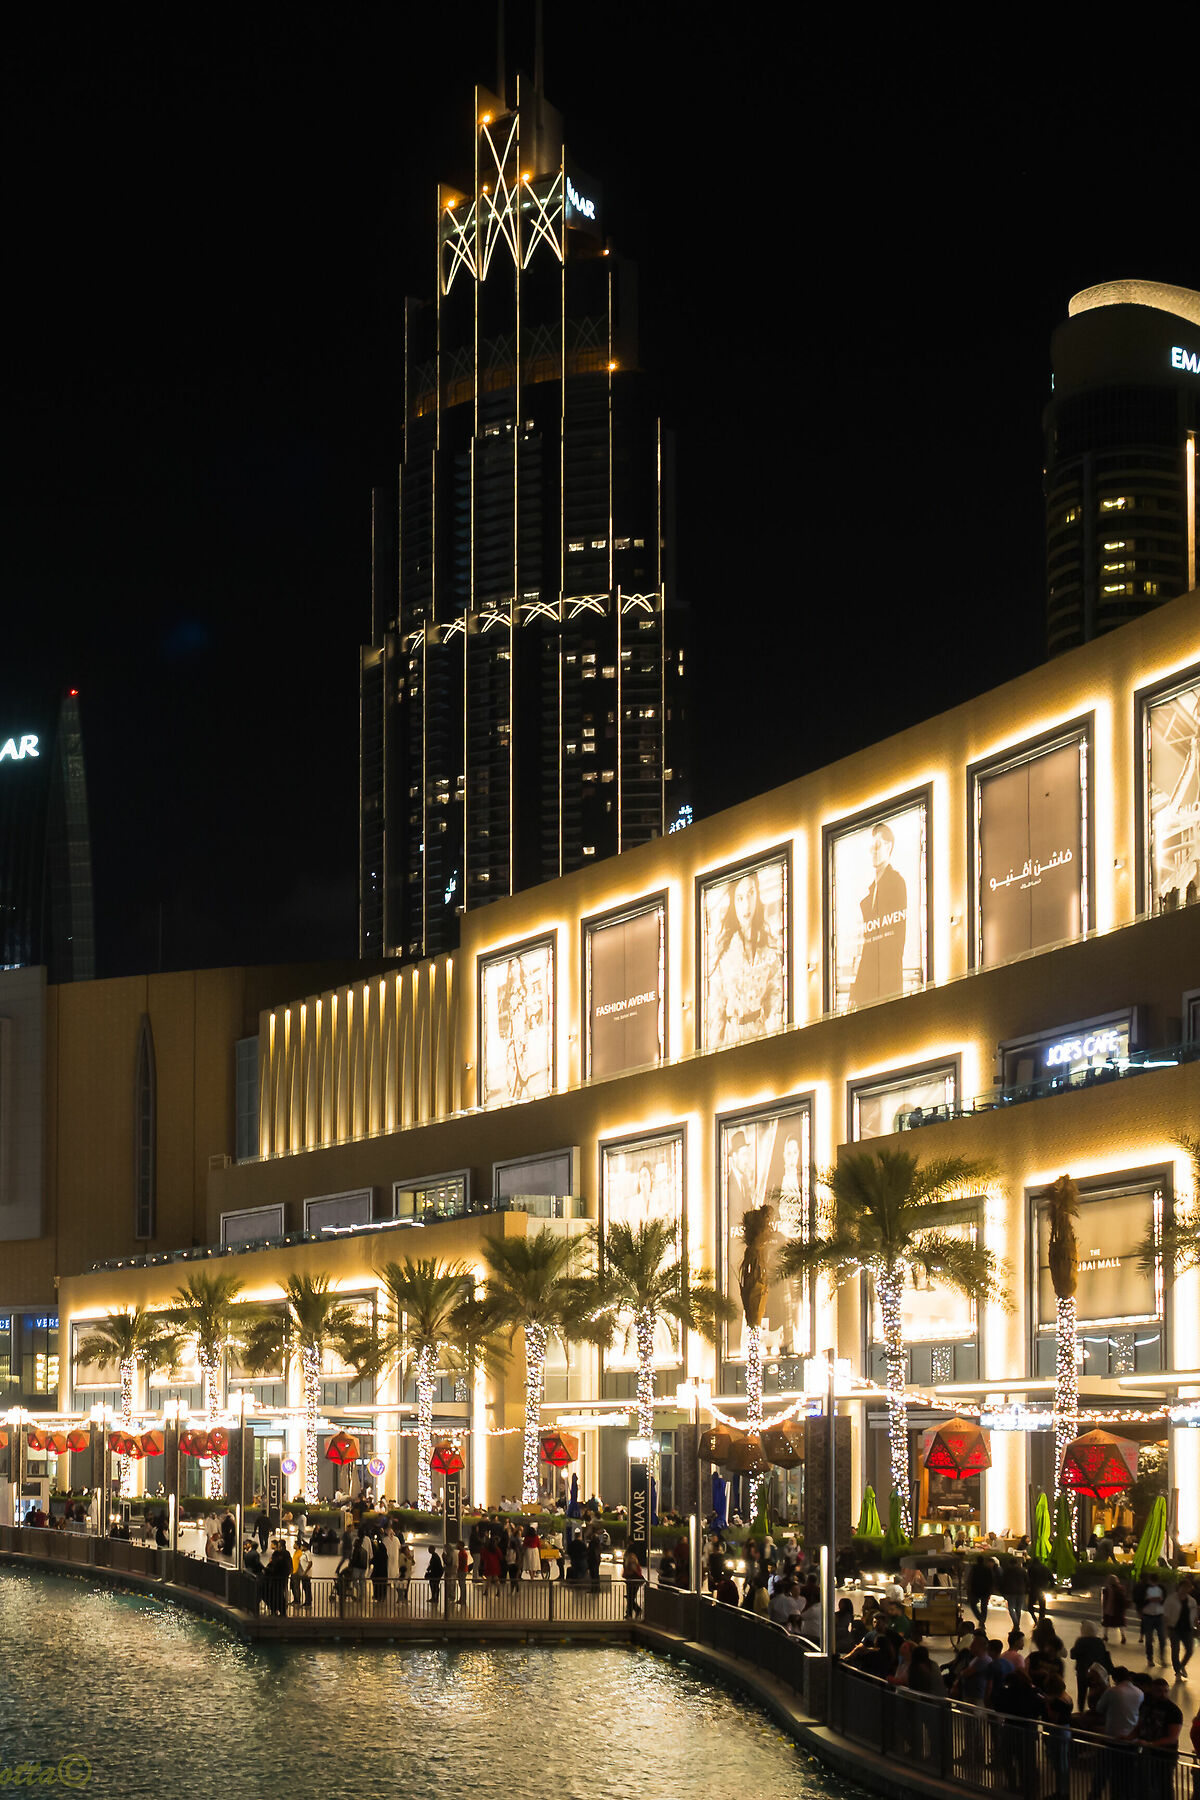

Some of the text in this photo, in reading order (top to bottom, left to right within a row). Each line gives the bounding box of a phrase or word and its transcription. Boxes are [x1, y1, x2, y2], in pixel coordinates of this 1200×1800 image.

[881, 908, 907, 928] AVEN
[595, 990, 657, 1017] FASHION AVENUE
[1089, 1248, 1100, 1256] THE
[1076, 1257, 1121, 1272] UBAI MALL
[633, 1490, 646, 1541] EMAAR
